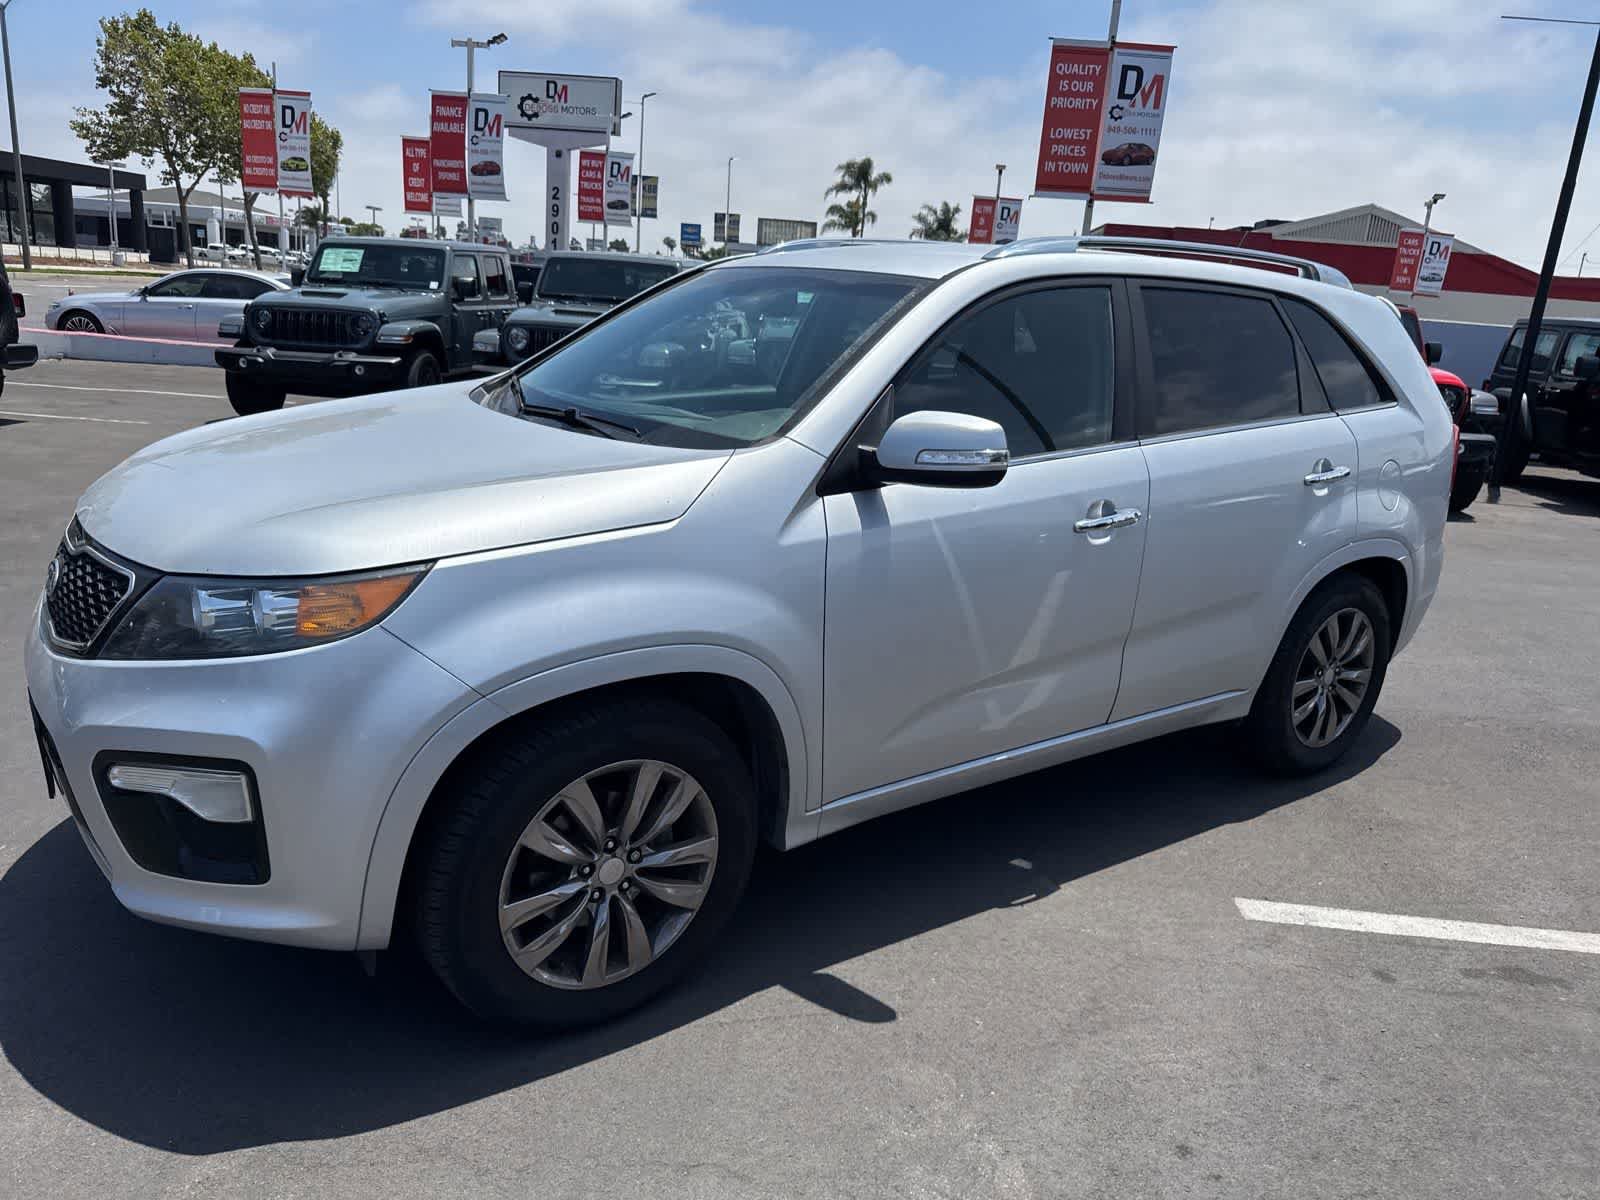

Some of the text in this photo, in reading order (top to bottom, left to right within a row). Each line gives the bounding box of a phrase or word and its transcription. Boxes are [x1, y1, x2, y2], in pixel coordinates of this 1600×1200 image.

[1056, 63, 1102, 76] QUALITY
[546, 80, 568, 104] DM
[1059, 80, 1094, 93] IS OUR
[1117, 64, 1165, 110] DM
[1050, 96, 1099, 110] PRIORITY
[436, 105, 463, 118] FINANCE
[561, 105, 597, 116] MOTORS
[281, 104, 307, 135] DM
[474, 107, 503, 138] DM
[433, 121, 465, 134] AVAILABLE
[1049, 127, 1093, 141] LOWEST
[406, 147, 427, 160] ALL TYPE
[1051, 144, 1087, 157] PRICES
[1044, 160, 1090, 175] IN TOWN
[408, 177, 425, 188] CREDIT
[406, 192, 429, 203] WELCOME
[1403, 238, 1419, 246] CARS
[1400, 247, 1420, 256] TRUCKS
